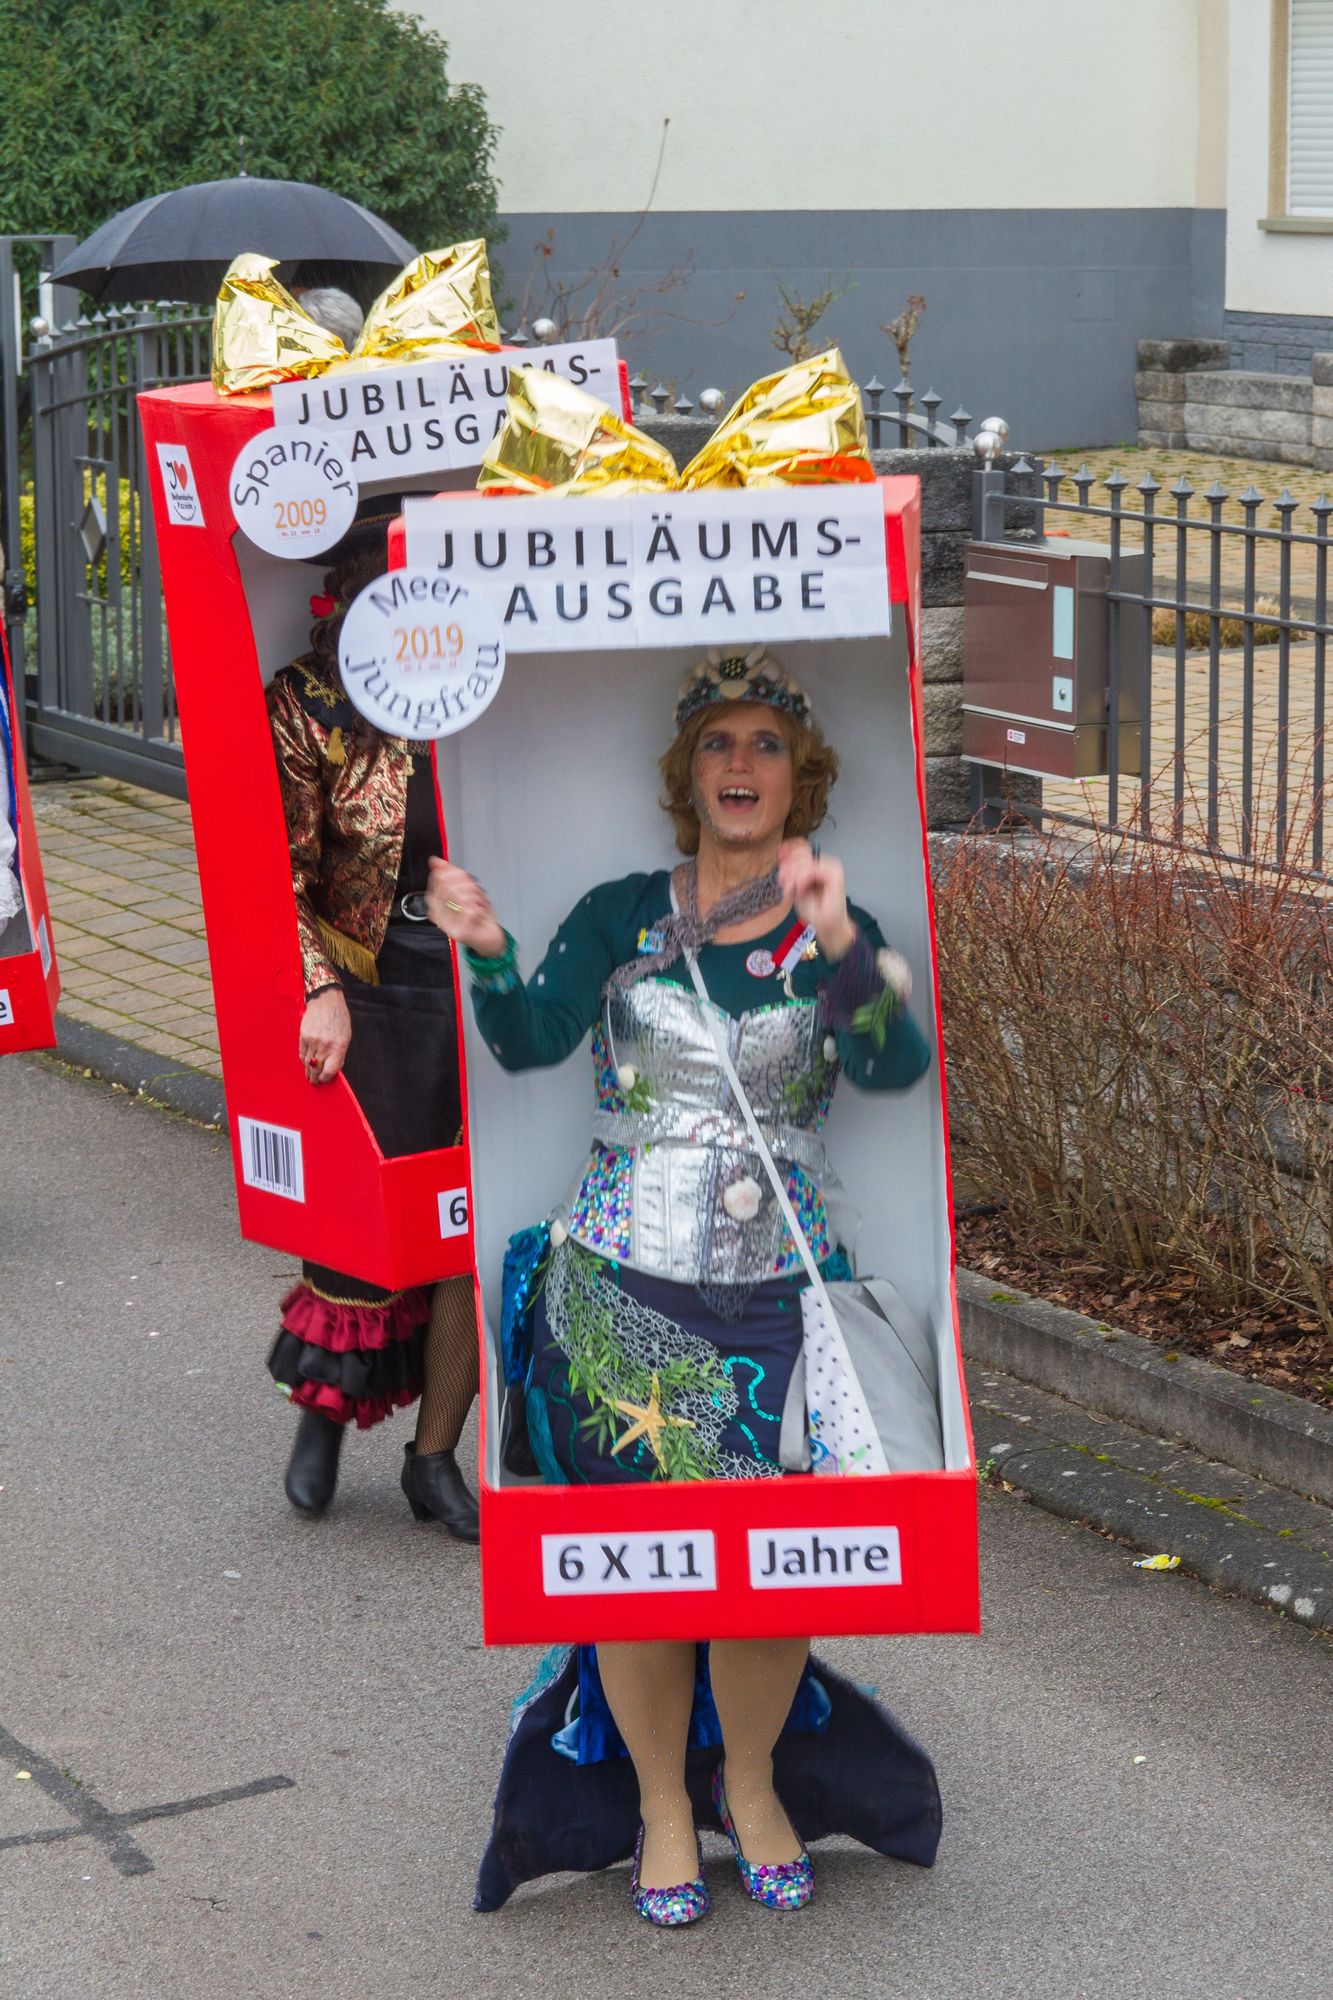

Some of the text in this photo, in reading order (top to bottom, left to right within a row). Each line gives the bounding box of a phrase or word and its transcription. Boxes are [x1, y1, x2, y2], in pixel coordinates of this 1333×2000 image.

[298, 354, 601, 425] JUBILÄUS-
[234, 440, 353, 506] Spanier
[274, 498, 327, 529] 2009
[437, 513, 862, 570] JUBILÄUMS-
[369, 574, 469, 618] Meer
[503, 571, 826, 625] AUSGABE
[394, 622, 464, 662] 2019
[449, 1196, 468, 1227] 6
[558, 1545, 585, 1581] 6
[648, 1541, 704, 1579] 11
[761, 1535, 890, 1578] Jahre
